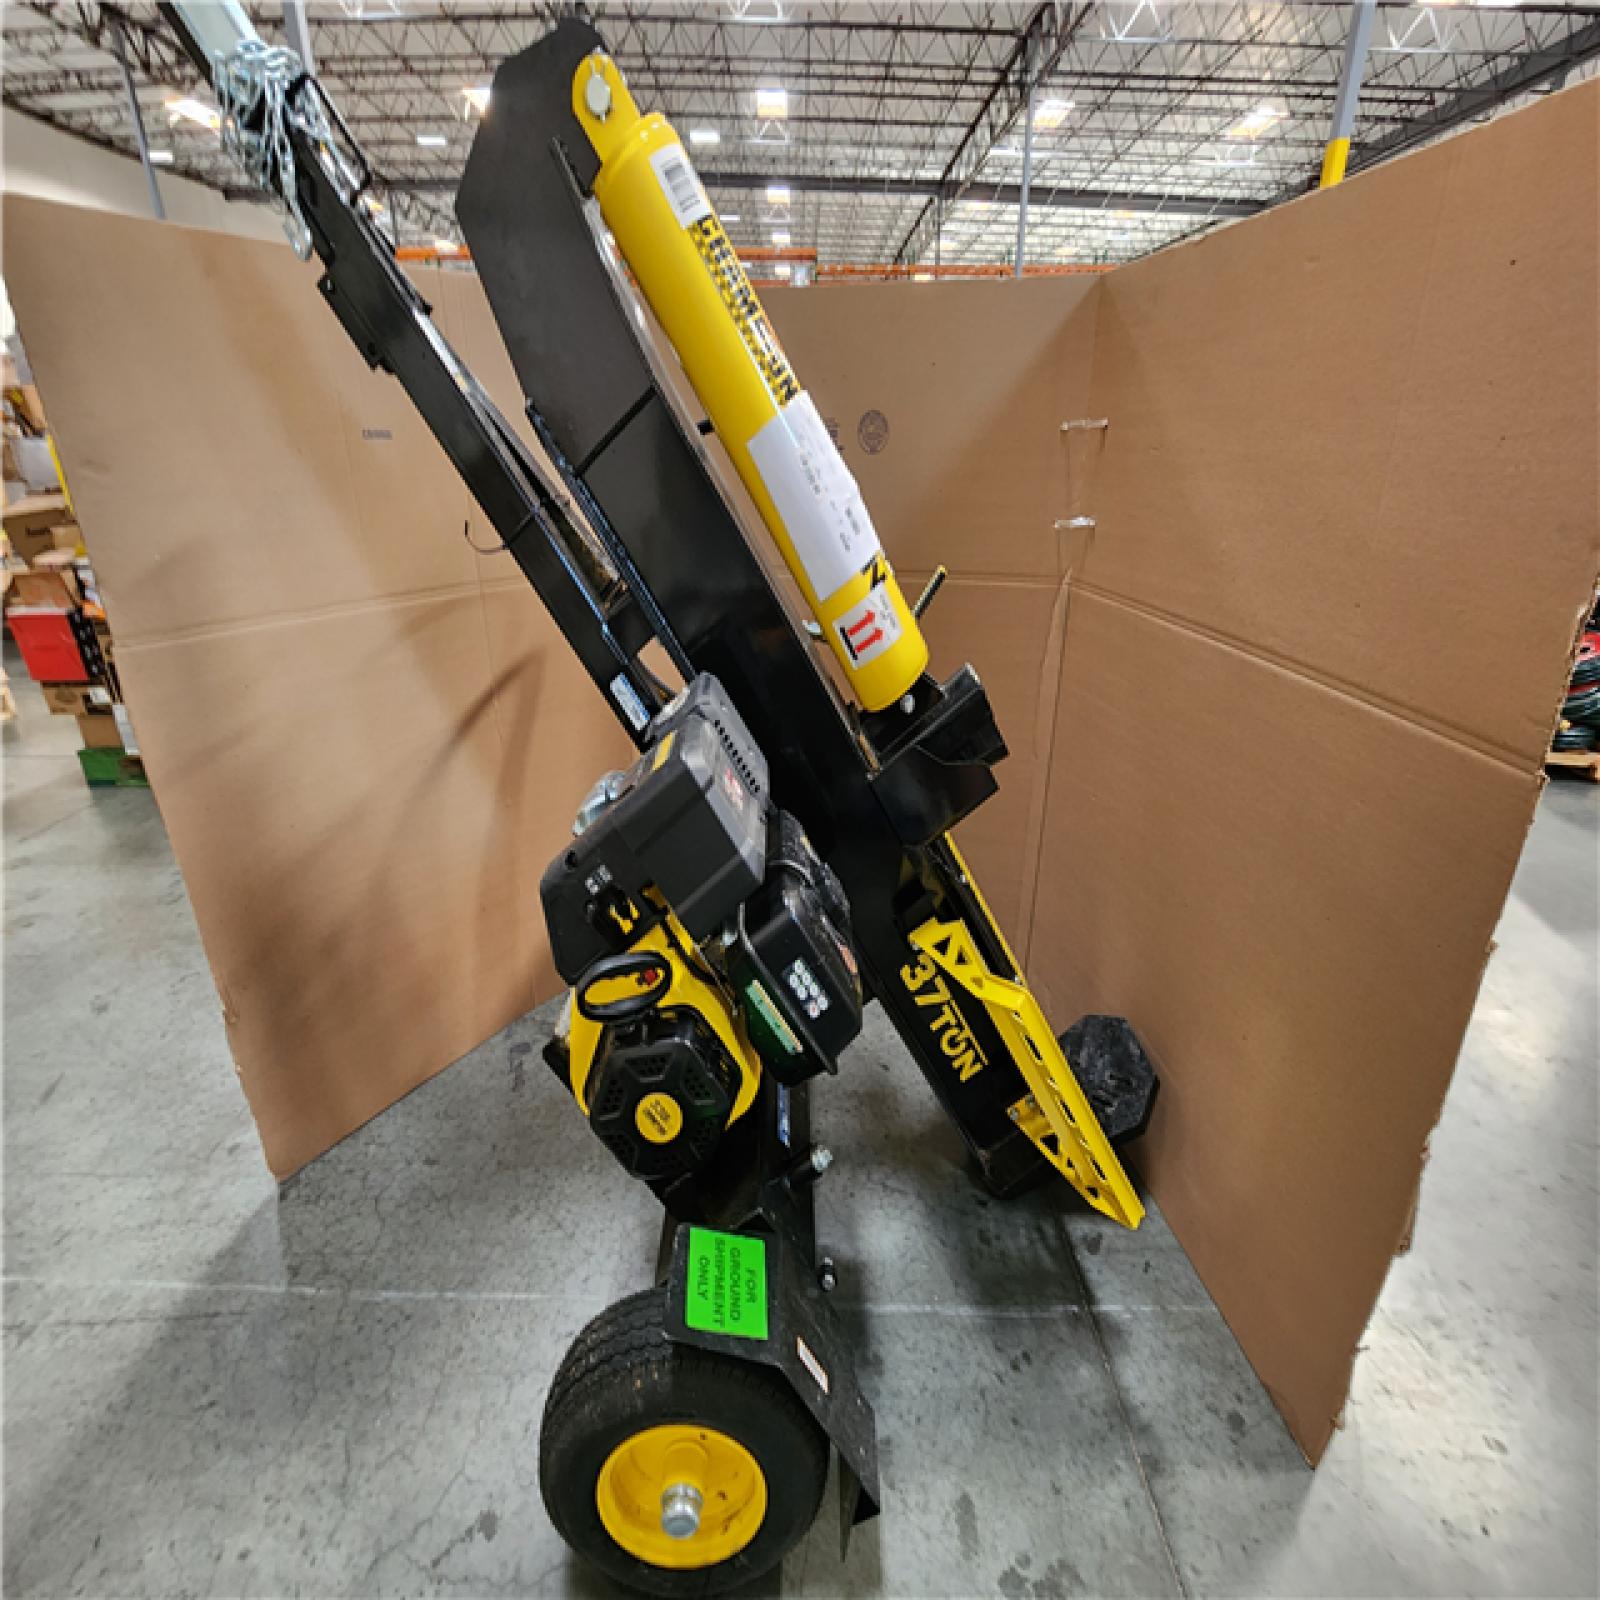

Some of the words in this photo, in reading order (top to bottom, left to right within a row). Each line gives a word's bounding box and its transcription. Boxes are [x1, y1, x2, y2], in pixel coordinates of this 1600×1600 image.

[698, 1255, 711, 1301] ONLY
[713, 1238, 726, 1328] SHIPMENT
[729, 1247, 741, 1322] GROUND
[745, 1267, 758, 1304] FOR
